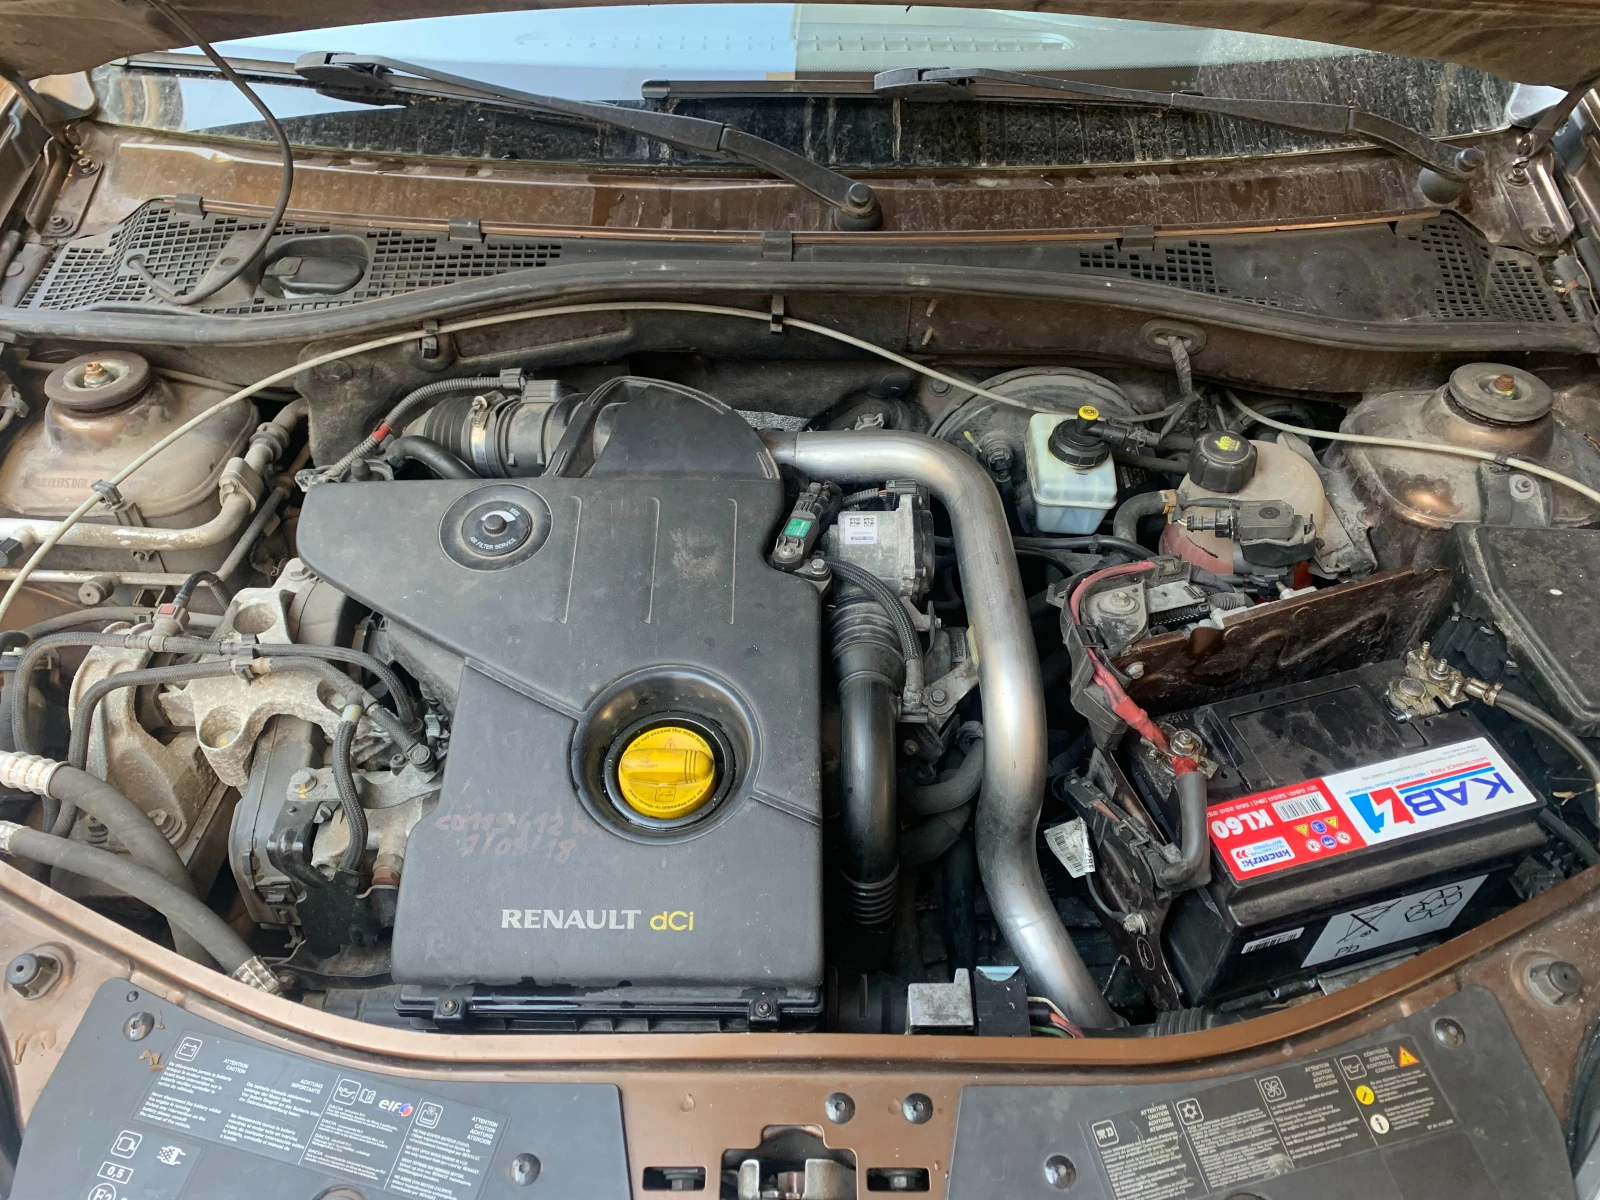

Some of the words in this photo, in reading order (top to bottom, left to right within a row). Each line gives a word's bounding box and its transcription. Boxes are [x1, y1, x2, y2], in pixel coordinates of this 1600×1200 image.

[469, 536, 477, 544] AIR
[476, 541, 493, 549] FILTER
[494, 537, 516, 549] SERVICE
[641, 734, 649, 742] not
[650, 728, 670, 736] exceed
[682, 730, 696, 739] maxi
[695, 736, 706, 748] level
[1445, 756, 1487, 770] MAINTENANCE
[1286, 787, 1305, 797] 60Ah
[1212, 810, 1274, 839] KL60
[501, 908, 642, 931] RENAULT
[650, 910, 694, 932] dCi
[1332, 942, 1360, 957] Pb
[222, 1057, 249, 1070] ATTENTION
[225, 1064, 246, 1075] CAUTION
[289, 1081, 321, 1095] IMPORTANTE
[299, 1078, 323, 1089] ACHTUNG
[378, 1099, 401, 1112] elf
[470, 1116, 498, 1128] ATTENTION
[473, 1123, 496, 1133] CAUTION
[469, 1128, 494, 1139] ACHTUNG
[106, 1166, 125, 1178] 0,5
